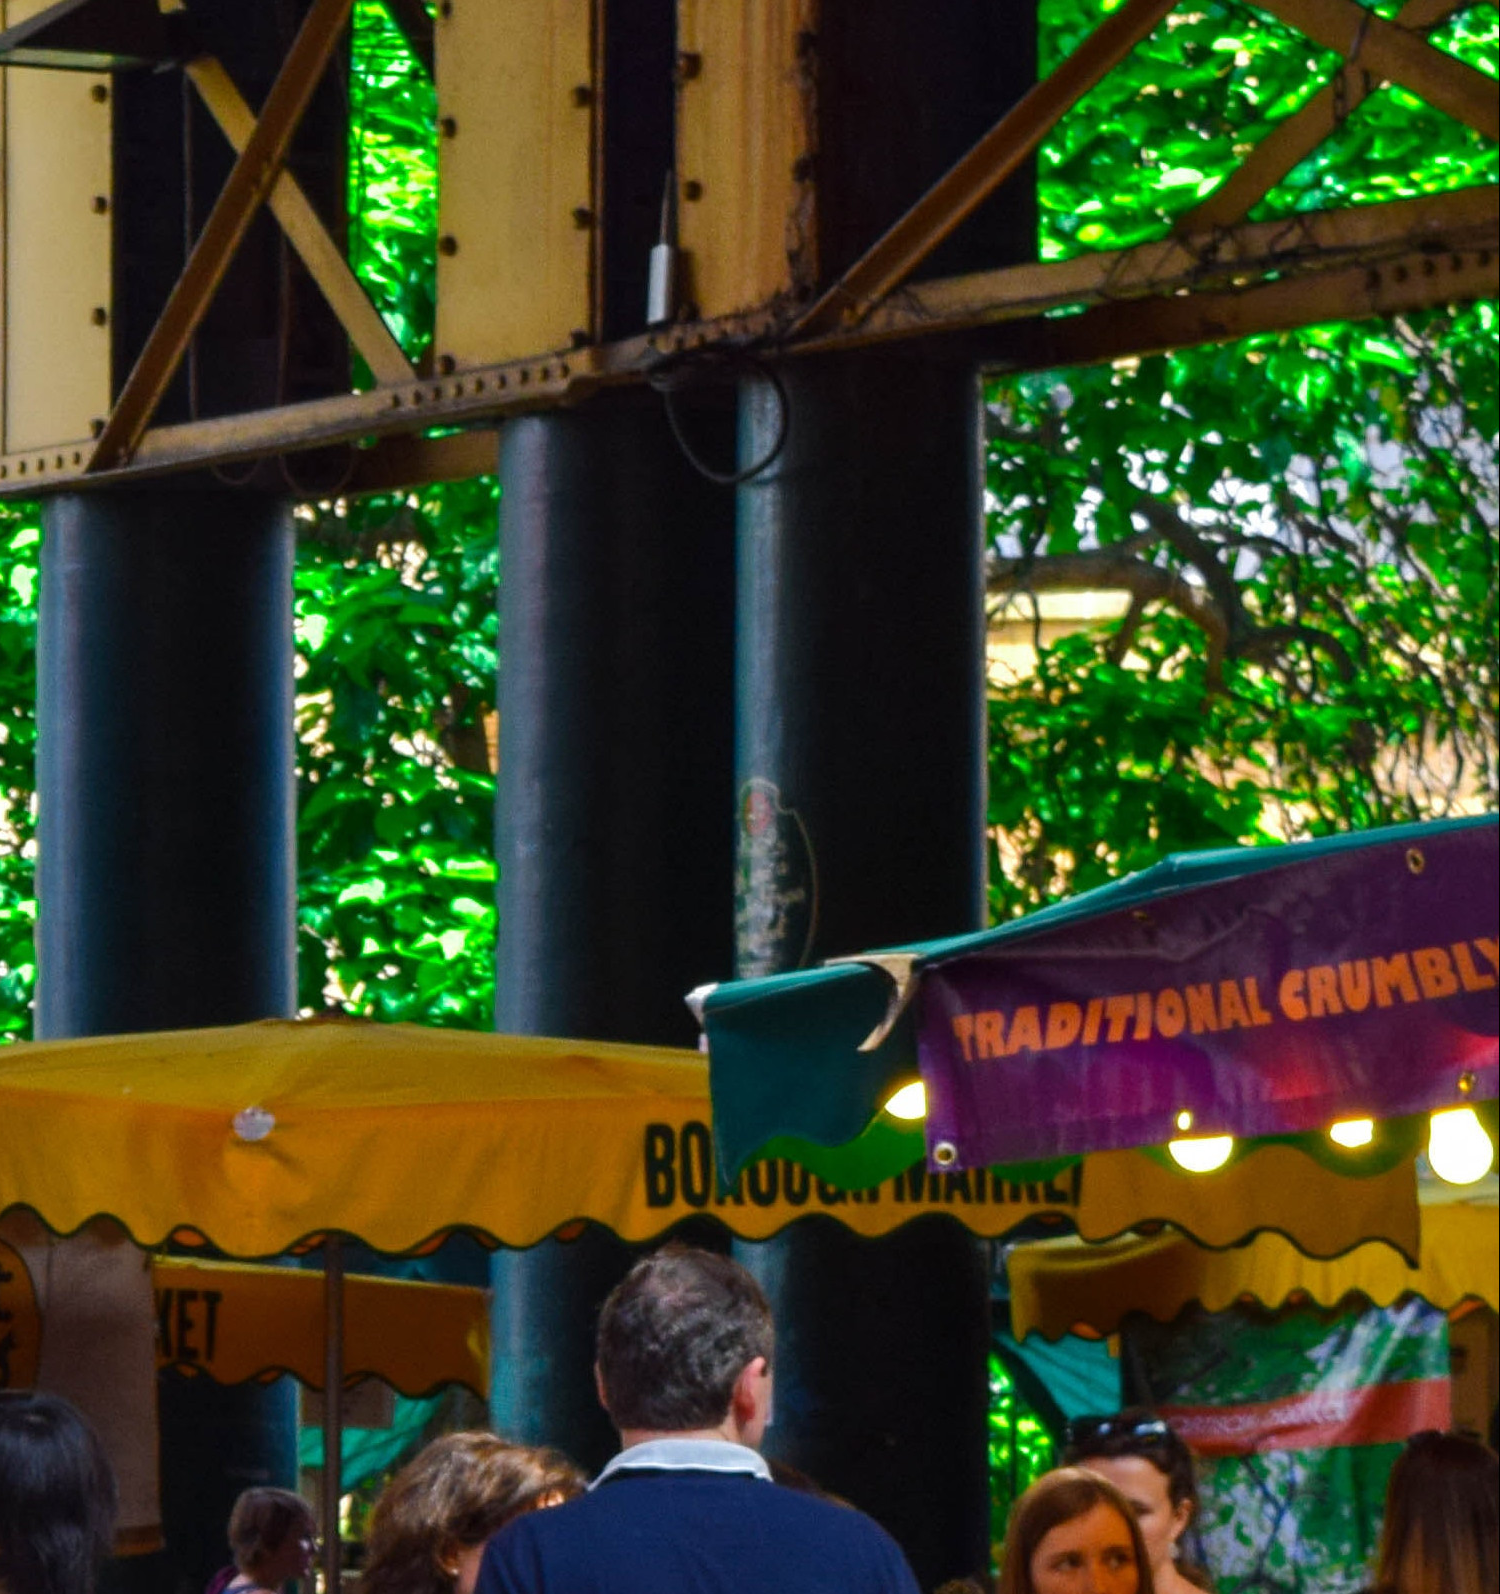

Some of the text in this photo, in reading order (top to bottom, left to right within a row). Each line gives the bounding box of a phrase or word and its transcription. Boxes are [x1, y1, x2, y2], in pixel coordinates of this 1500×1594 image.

[953, 935, 1499, 1063] TRADITIONAL CRUMBLY
[644, 1120, 882, 1208] BOOU
